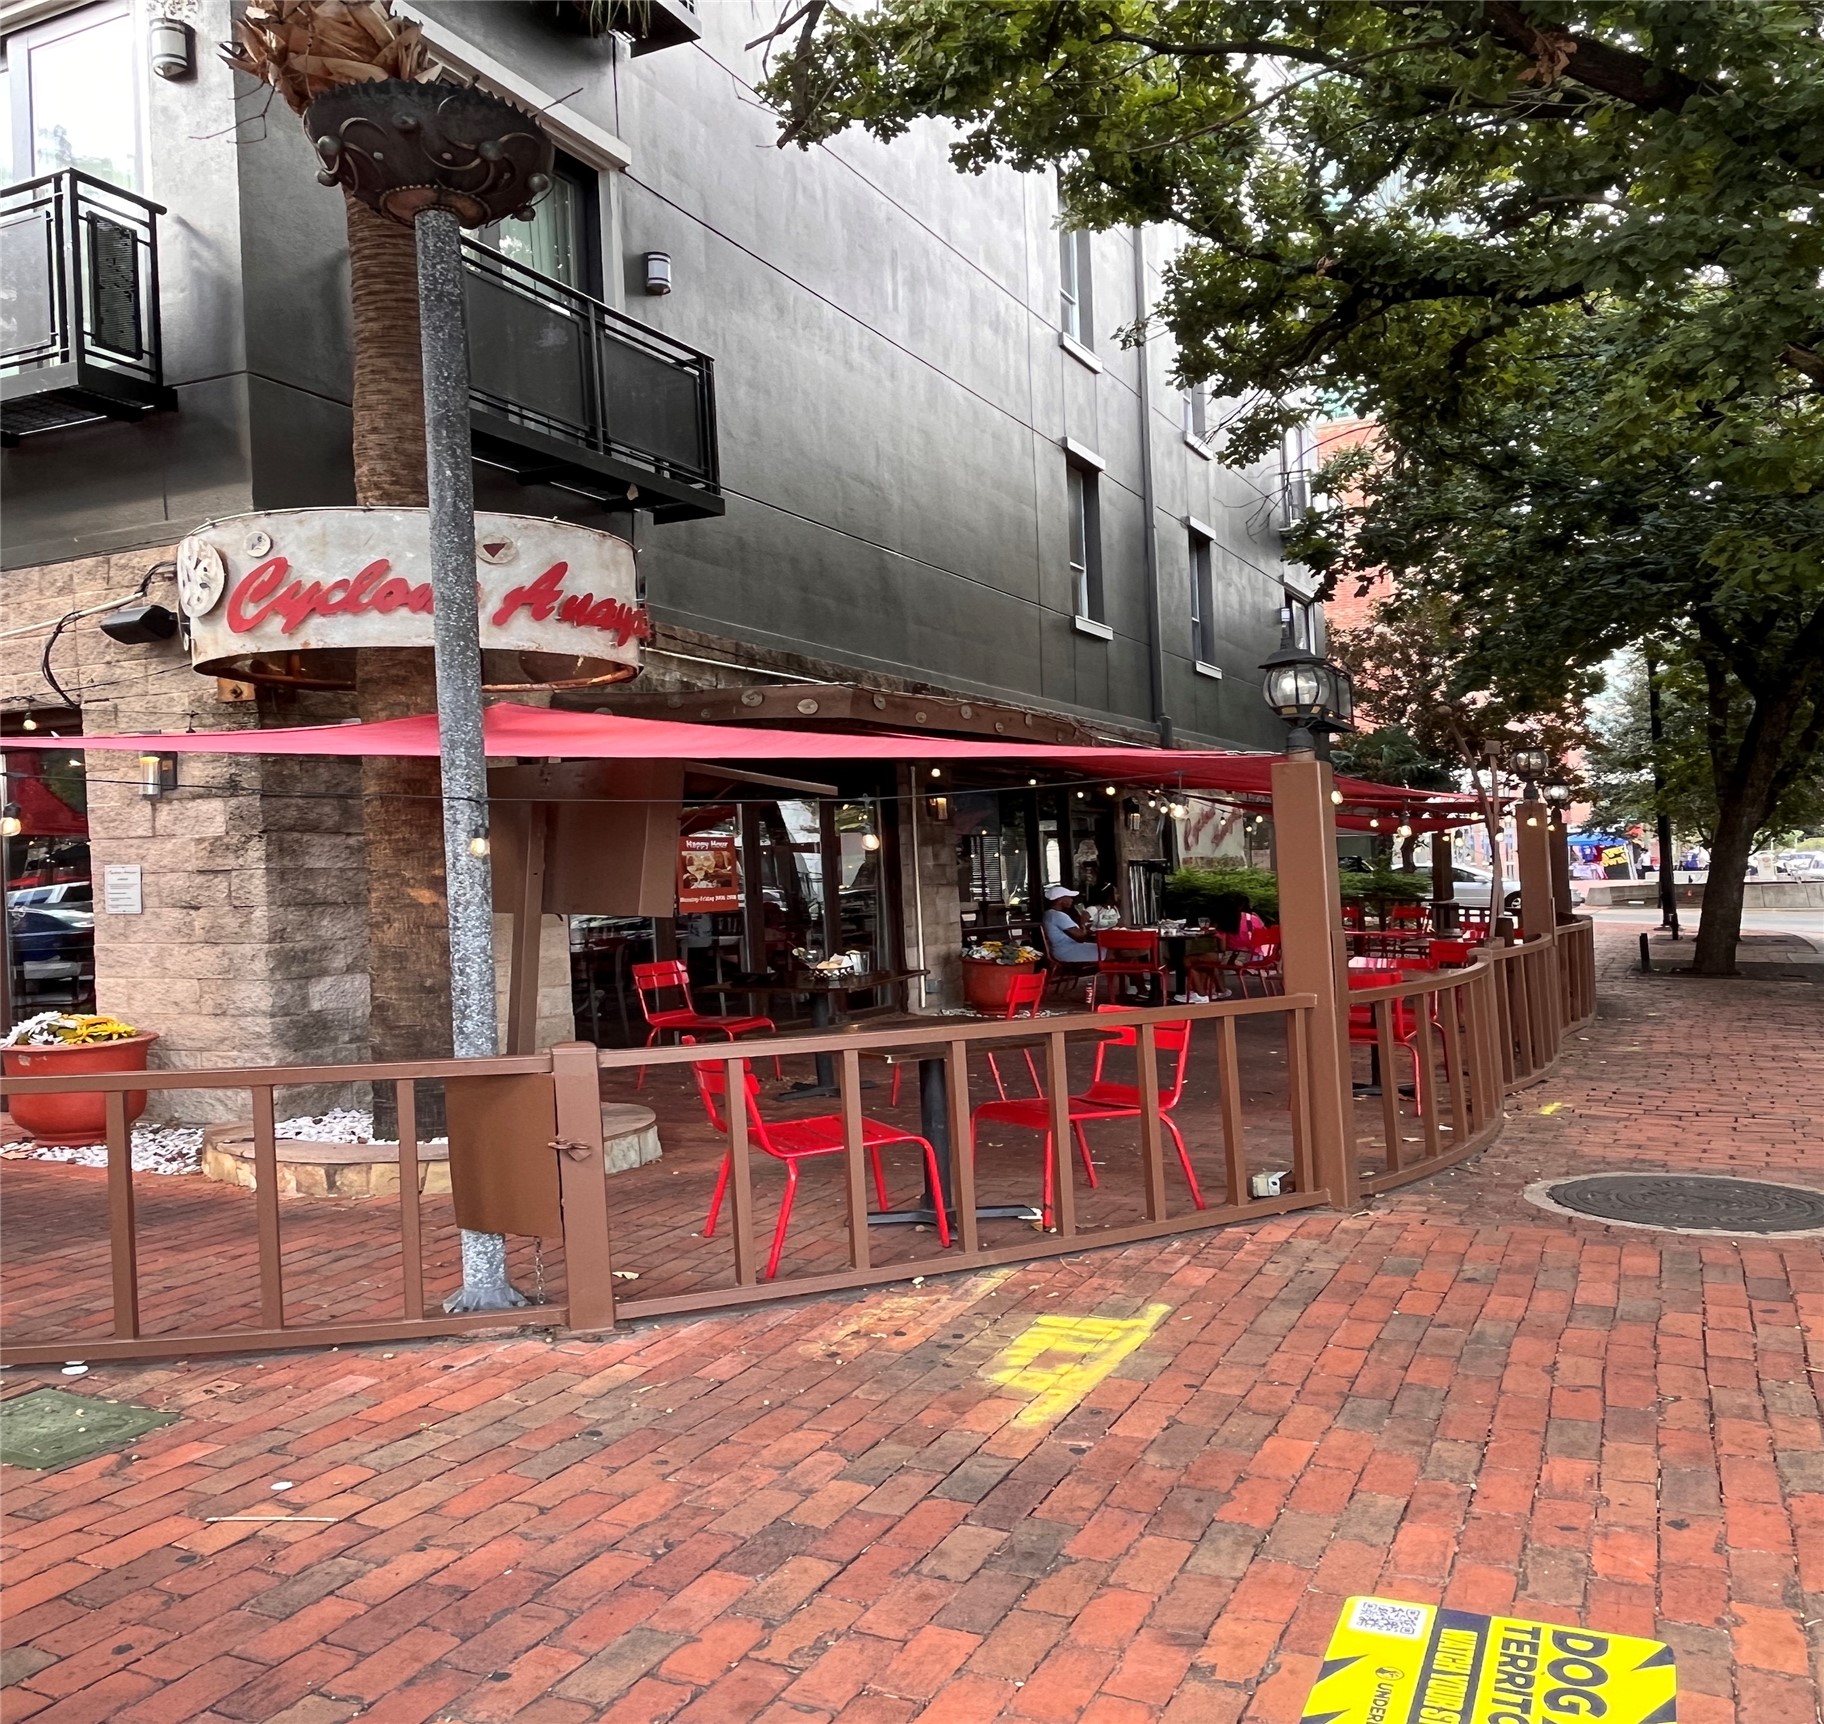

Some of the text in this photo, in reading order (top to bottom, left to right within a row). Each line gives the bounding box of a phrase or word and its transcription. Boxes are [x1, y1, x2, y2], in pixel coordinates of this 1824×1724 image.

[685, 840, 728, 850] Happy Hour
[1432, 1628, 1478, 1675] WATCH
[1423, 1673, 1469, 1712] YOUR
[1543, 1629, 1609, 1718] DOG
[1366, 1682, 1394, 1724] UNDER
